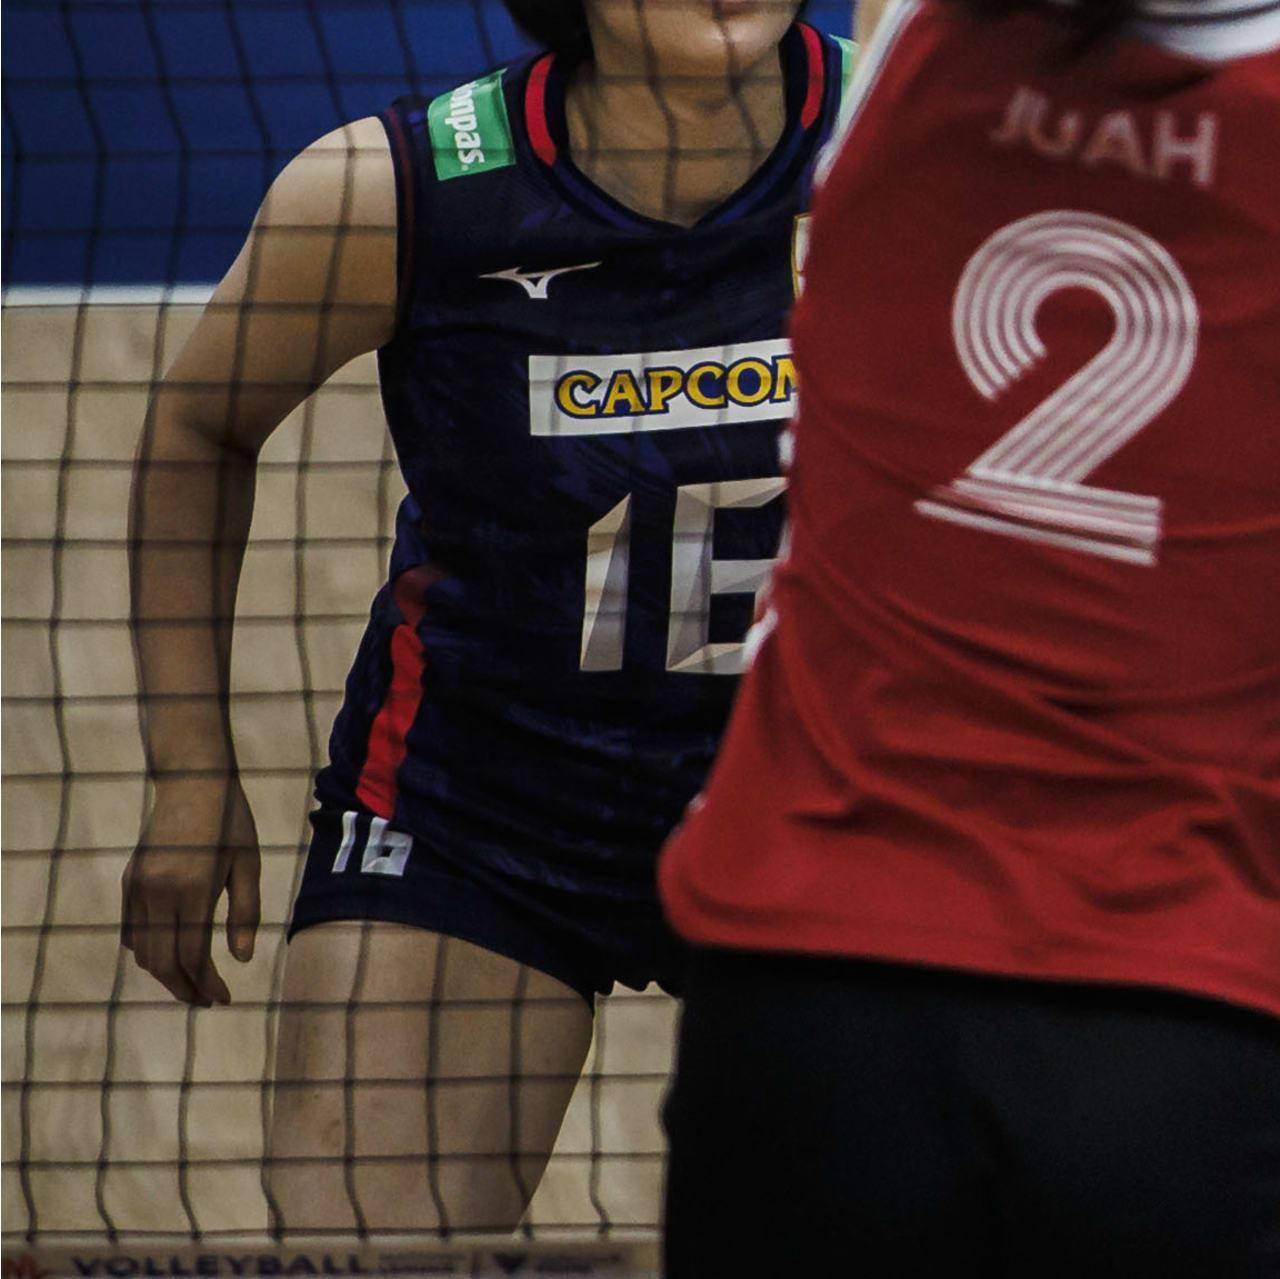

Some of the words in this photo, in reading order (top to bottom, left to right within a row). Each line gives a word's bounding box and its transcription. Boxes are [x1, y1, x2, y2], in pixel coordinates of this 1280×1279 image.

[990, 86, 1219, 186] JUAH
[913, 208, 1201, 568] 2
[331, 810, 414, 877] 16
[71, 1254, 366, 1278] VOLLEYBALL
